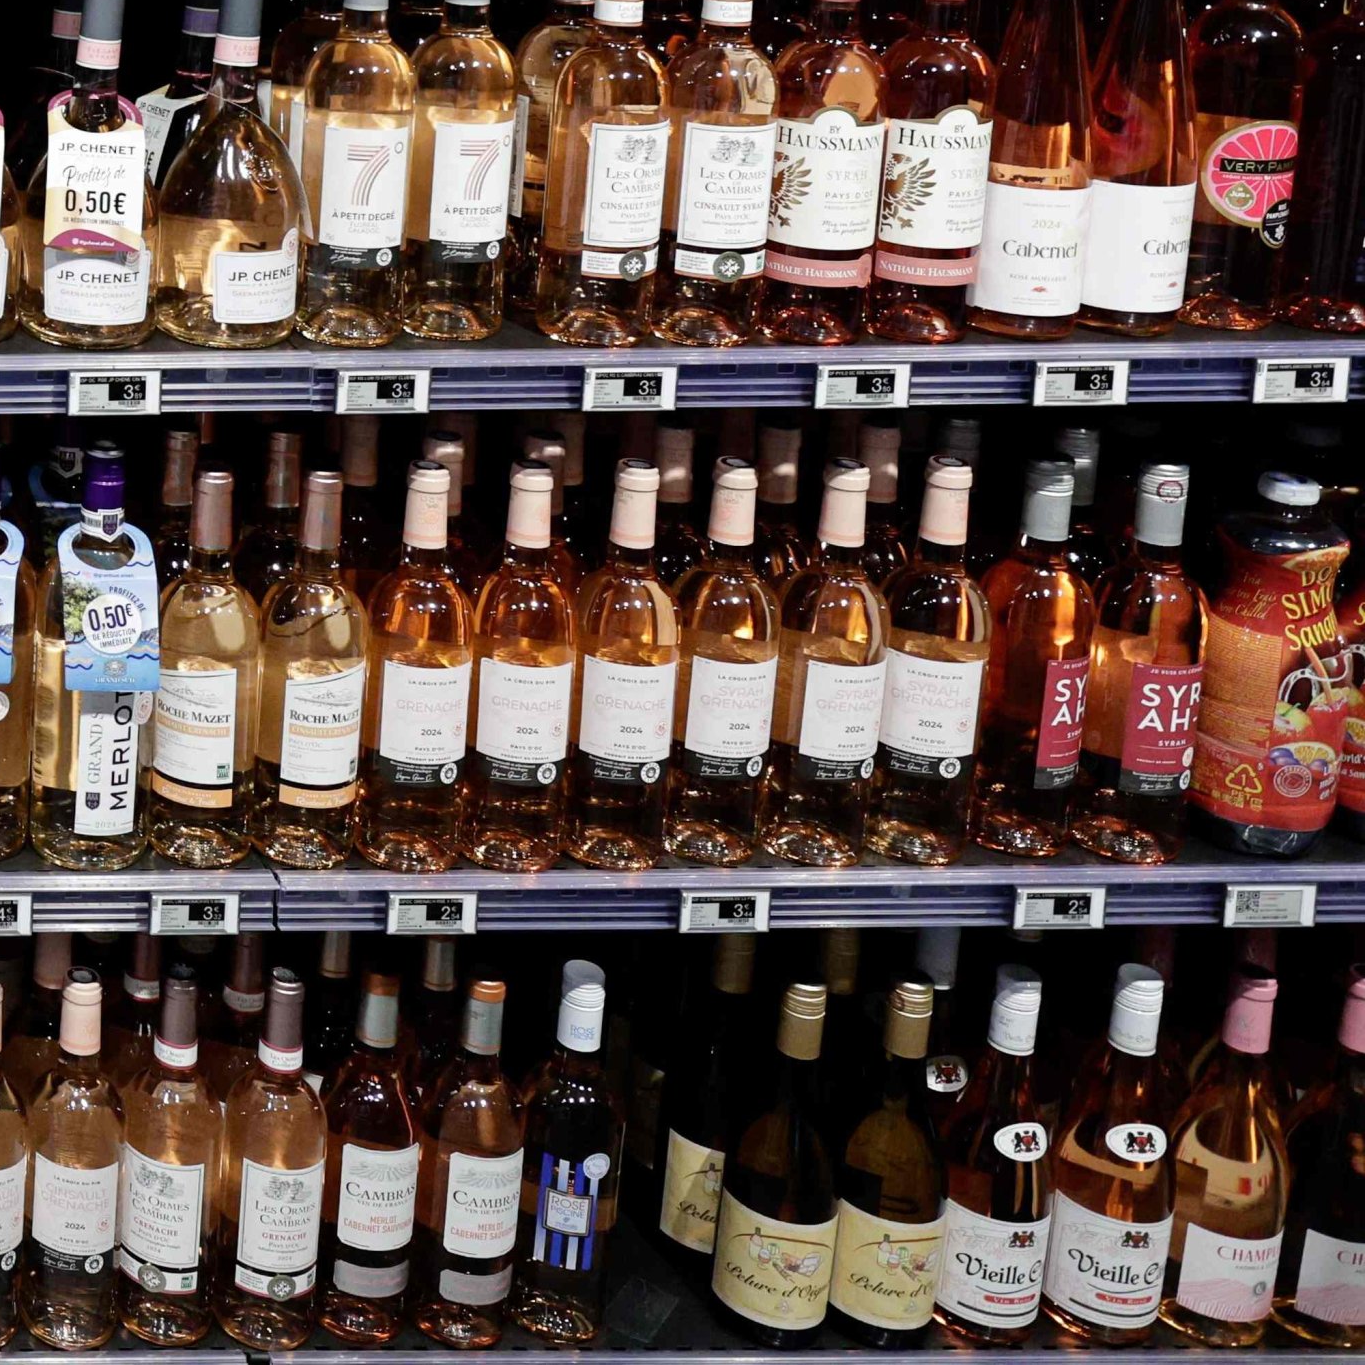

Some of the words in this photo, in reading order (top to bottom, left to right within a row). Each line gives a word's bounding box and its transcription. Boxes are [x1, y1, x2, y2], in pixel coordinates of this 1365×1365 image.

[339, 211, 367, 220] PETIT
[369, 209, 396, 221] DEGRÉ
[87, 607, 133, 634] 0,50€
[918, 720, 943, 729] 2024
[1158, 739, 1187, 747] SYRAH
[956, 1252, 1024, 1285] Vieille
